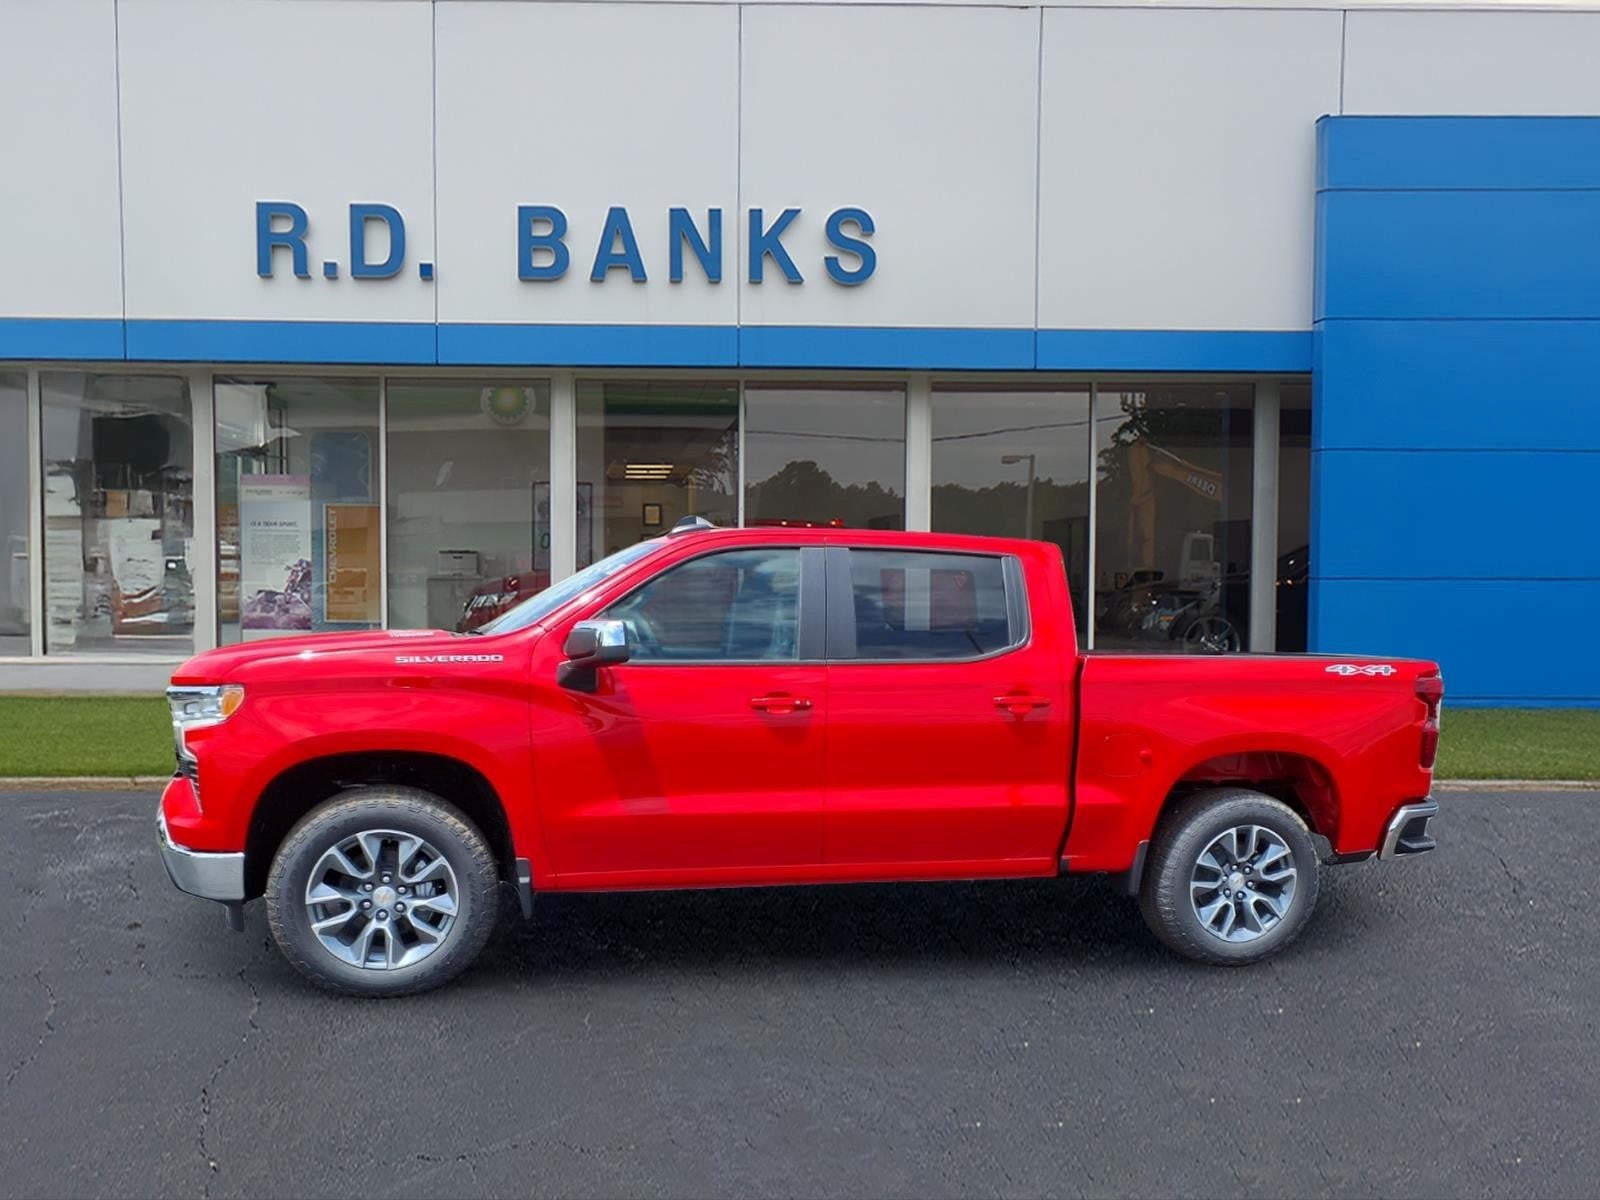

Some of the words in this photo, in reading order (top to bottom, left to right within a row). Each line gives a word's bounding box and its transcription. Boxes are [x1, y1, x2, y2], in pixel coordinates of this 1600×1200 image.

[256, 202, 433, 279] R.D.
[517, 205, 877, 285] BANKS
[328, 507, 337, 583] CHEVROLET
[395, 655, 504, 664] SILVERADO
